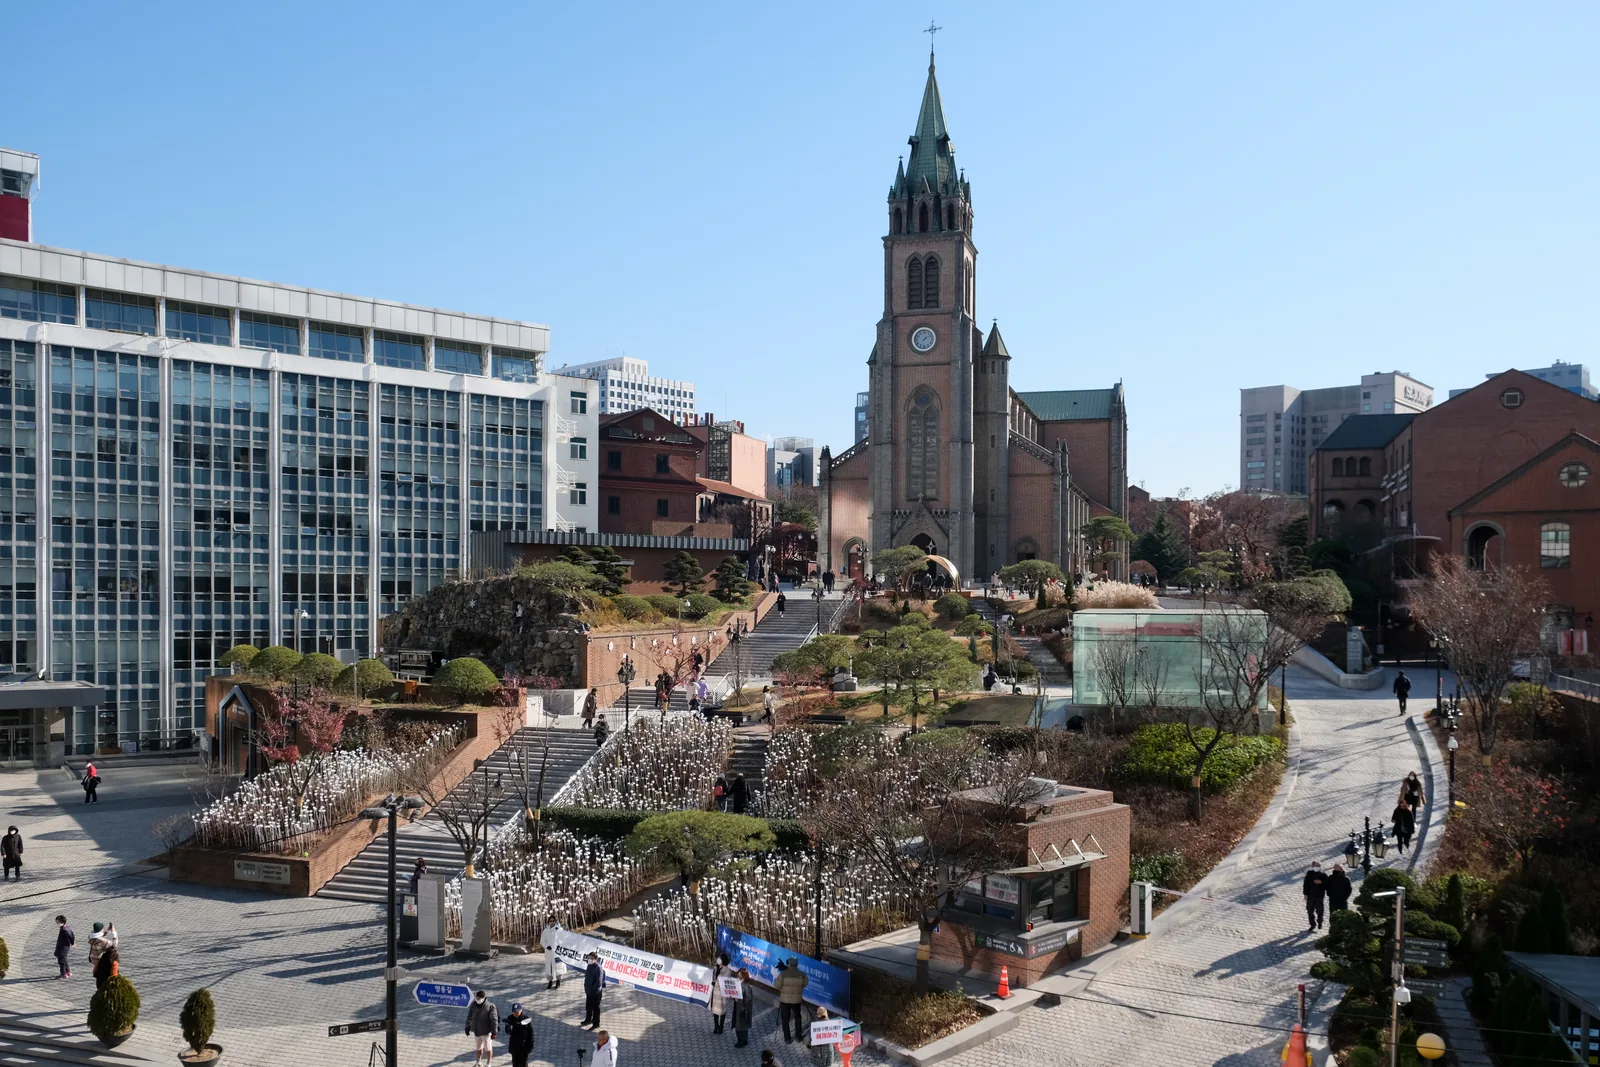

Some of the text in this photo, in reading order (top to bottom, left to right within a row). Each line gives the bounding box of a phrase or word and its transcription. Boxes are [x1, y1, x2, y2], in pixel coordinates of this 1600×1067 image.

[555, 945, 581, 961] 천주교는
[604, 960, 655, 982] 비나이다신부를
[656, 973, 672, 985] 영구
[673, 978, 709, 994] 파면하라!
[596, 947, 663, 971] 대통령 전용기 추락 기원 신부
[434, 985, 452, 994] 명동길
